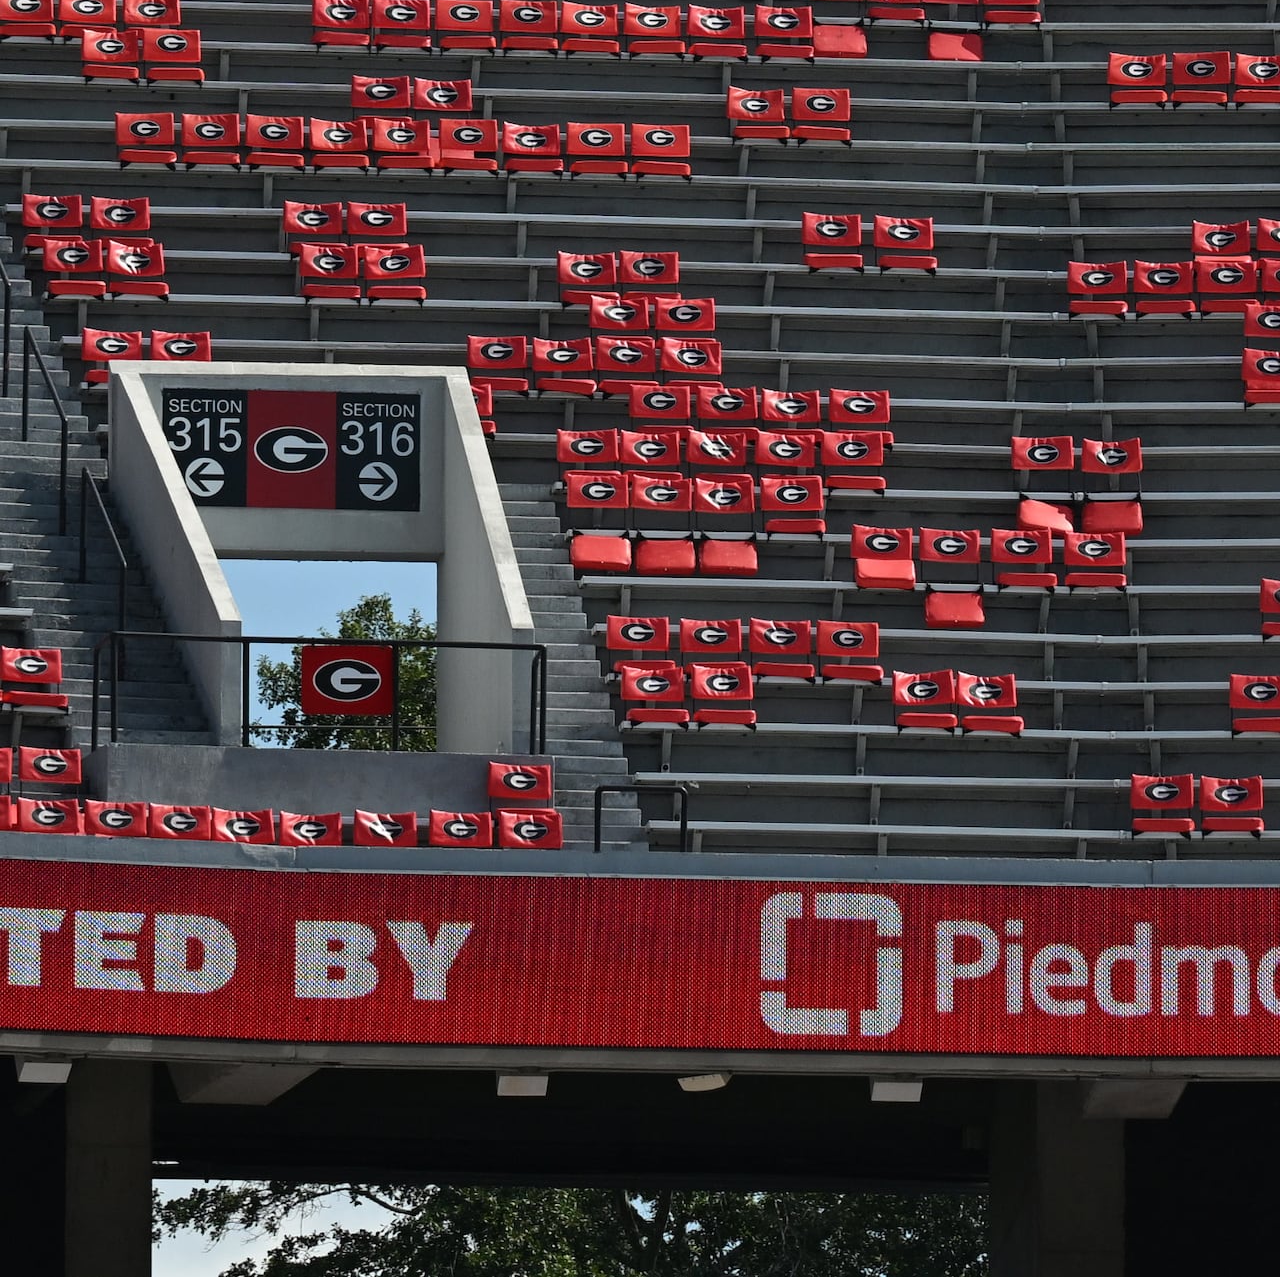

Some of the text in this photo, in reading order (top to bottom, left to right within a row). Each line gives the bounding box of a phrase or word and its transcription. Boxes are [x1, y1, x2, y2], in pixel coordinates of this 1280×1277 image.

[168, 398, 243, 414] SECTION
[342, 402, 415, 418] SECTION
[167, 416, 242, 453] 315
[340, 420, 415, 457] 316
[0, 907, 474, 1001] TED BY
